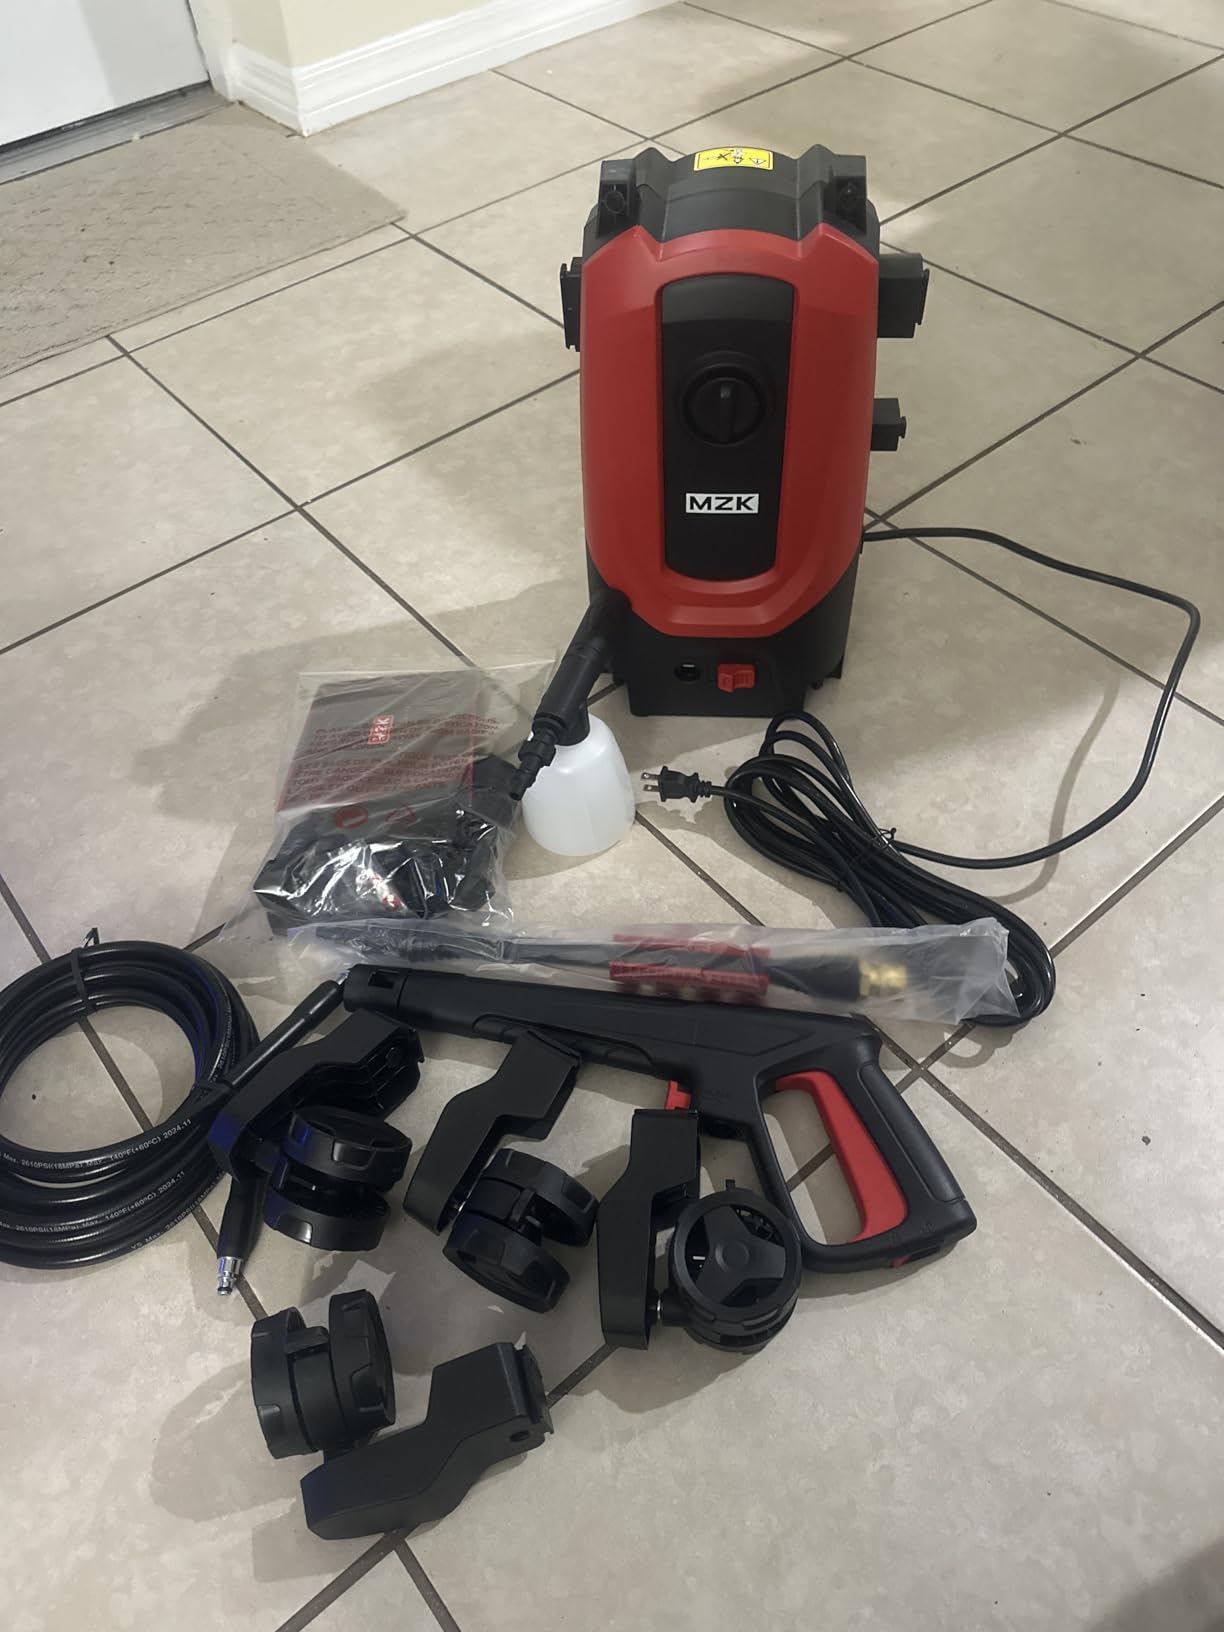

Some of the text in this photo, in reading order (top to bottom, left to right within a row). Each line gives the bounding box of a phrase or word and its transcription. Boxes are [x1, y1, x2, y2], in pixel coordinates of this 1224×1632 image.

[689, 496, 756, 511] MZK
[162, 1117, 193, 1139] 2024.11
[158, 1170, 186, 1194] 2024.11
